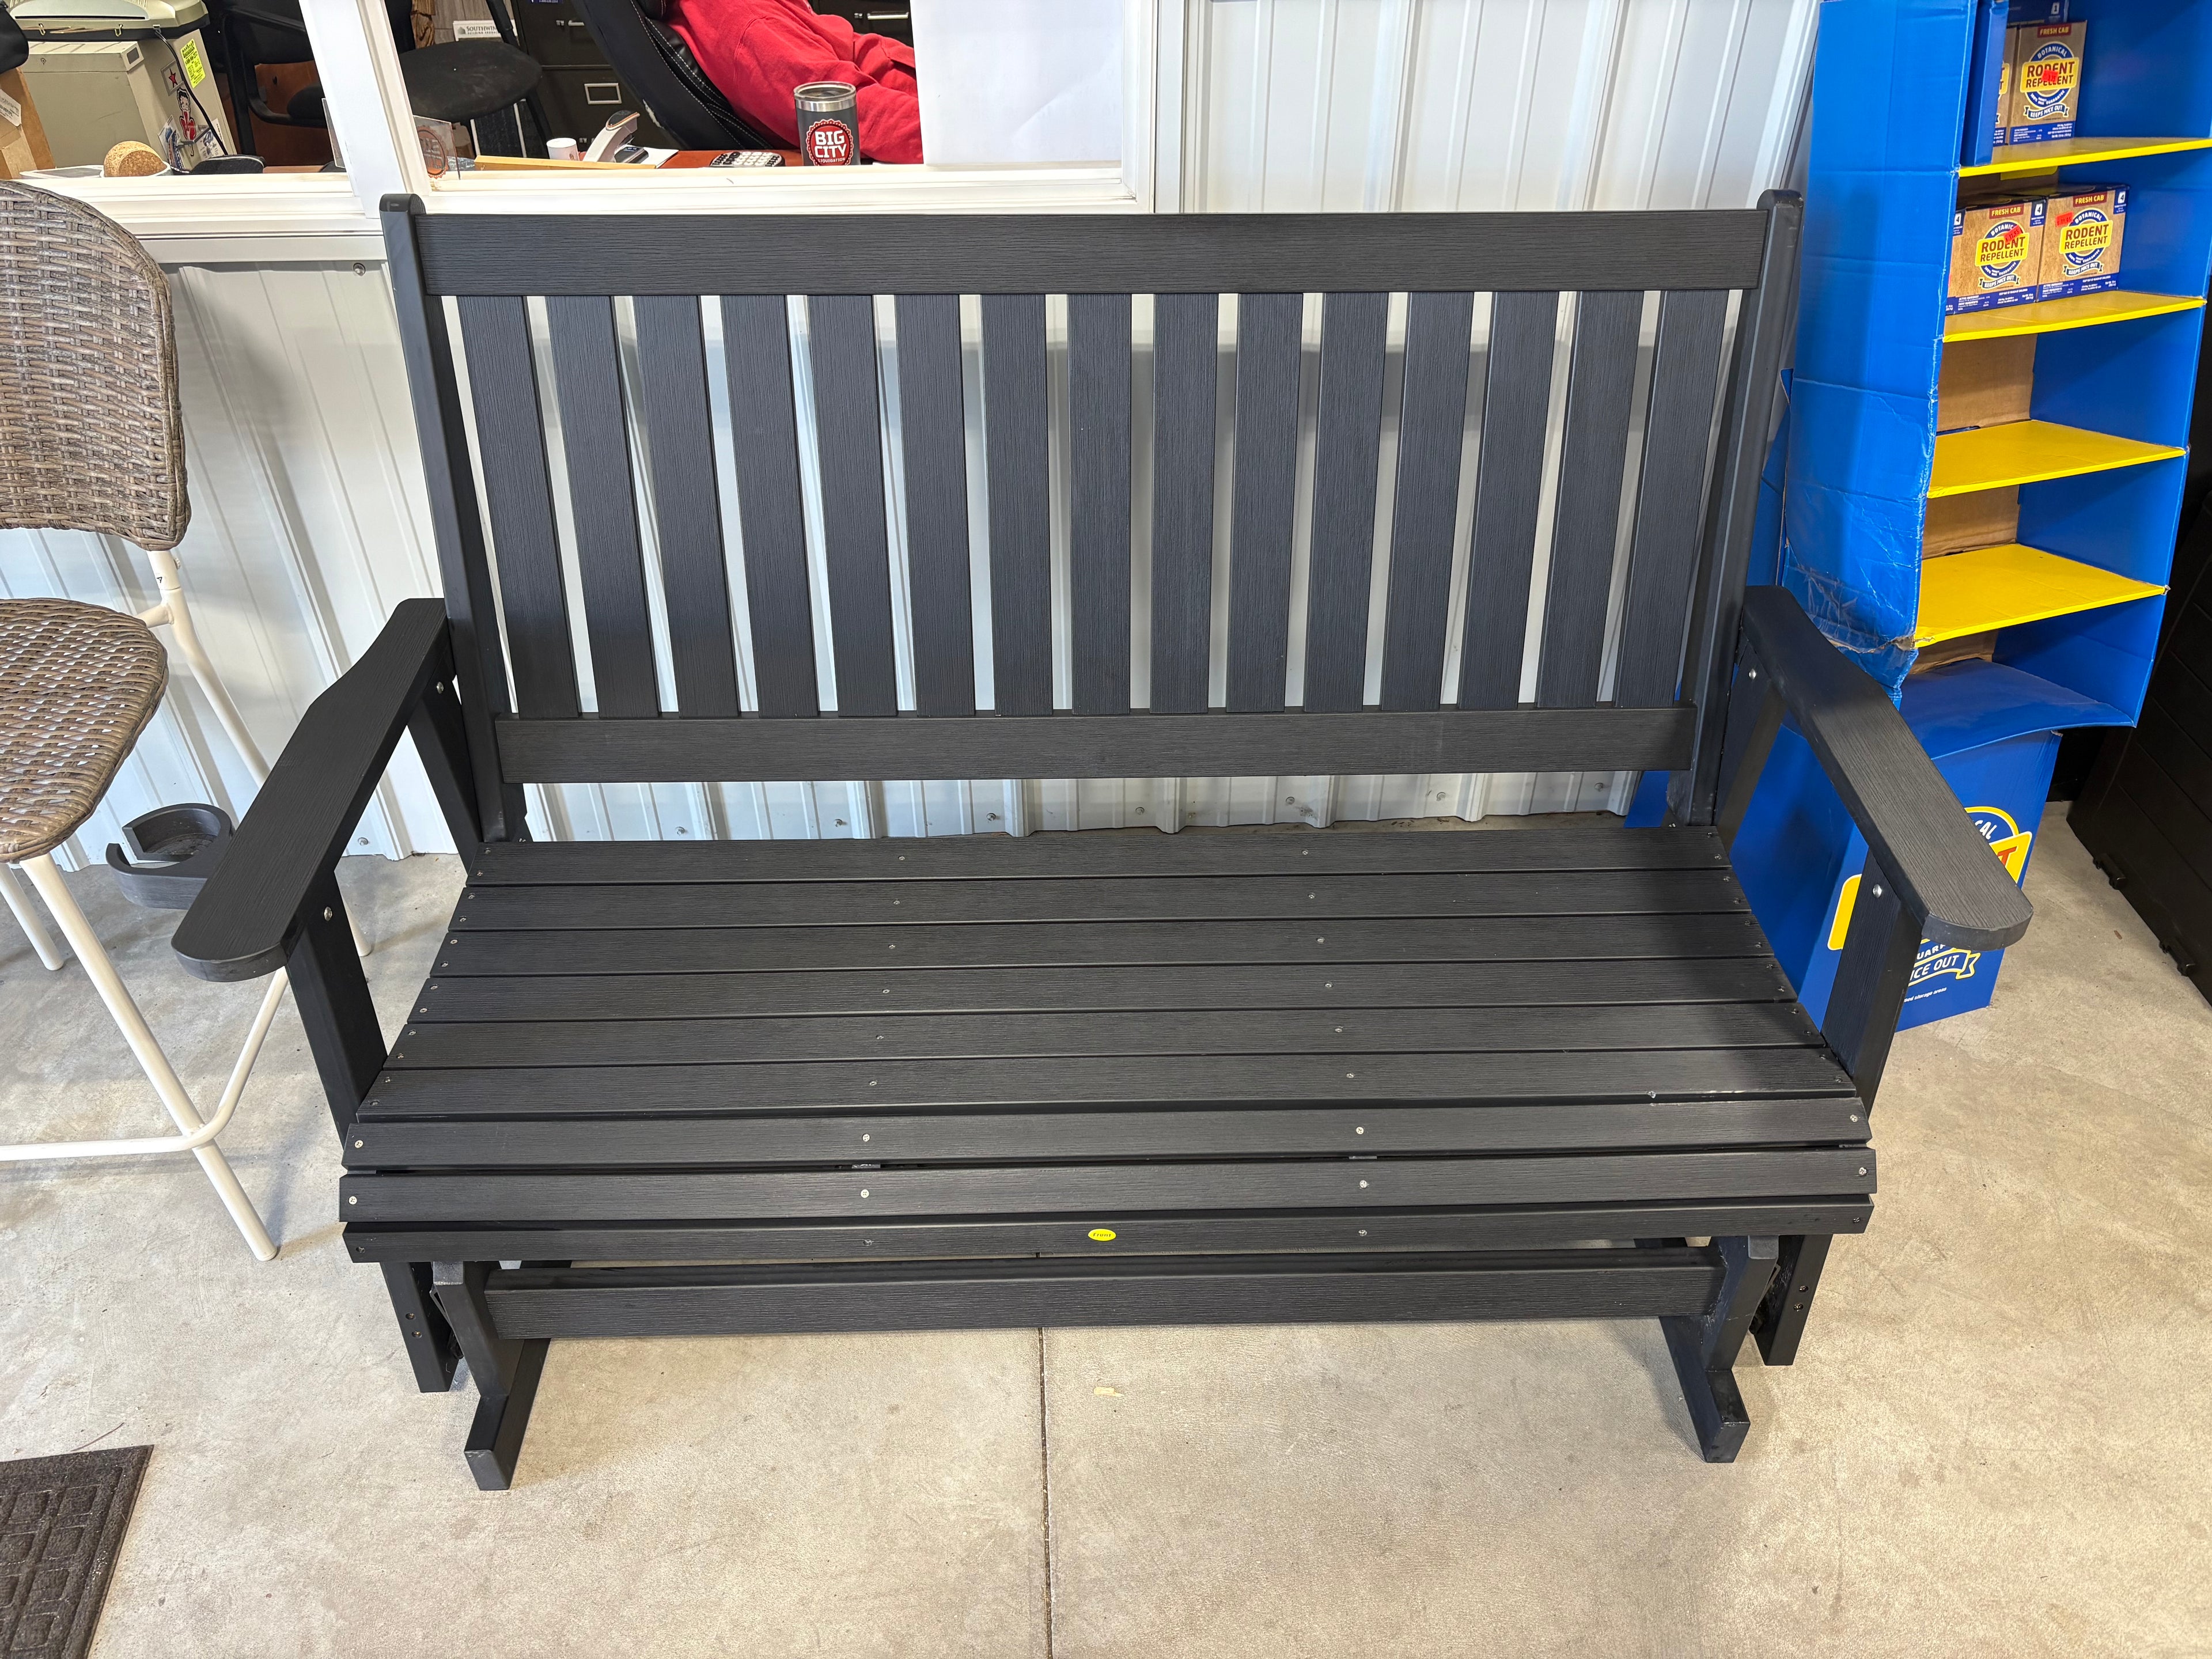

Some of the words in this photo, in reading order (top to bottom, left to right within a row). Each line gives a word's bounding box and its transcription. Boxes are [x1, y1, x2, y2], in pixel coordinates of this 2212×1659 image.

[2037, 46, 2067, 59] BOTANICAL
[815, 130, 845, 145] BIG
[814, 143, 847, 158] CITY
[2075, 196, 2093, 204] FRESH
[1991, 208, 2009, 217] FRESH
[2075, 212, 2102, 224] BOTANICAL
[1991, 224, 2014, 236] BOTANIC
[2066, 225, 2109, 240] RODENT
[2065, 236, 2108, 249] REPELLENT
[1980, 248, 2024, 262] REPELLENT
[1910, 963, 1931, 981] ICE
[1933, 955, 1960, 971] OUT
[1914, 991, 1933, 1000] storage
[1933, 987, 1947, 995] areas
